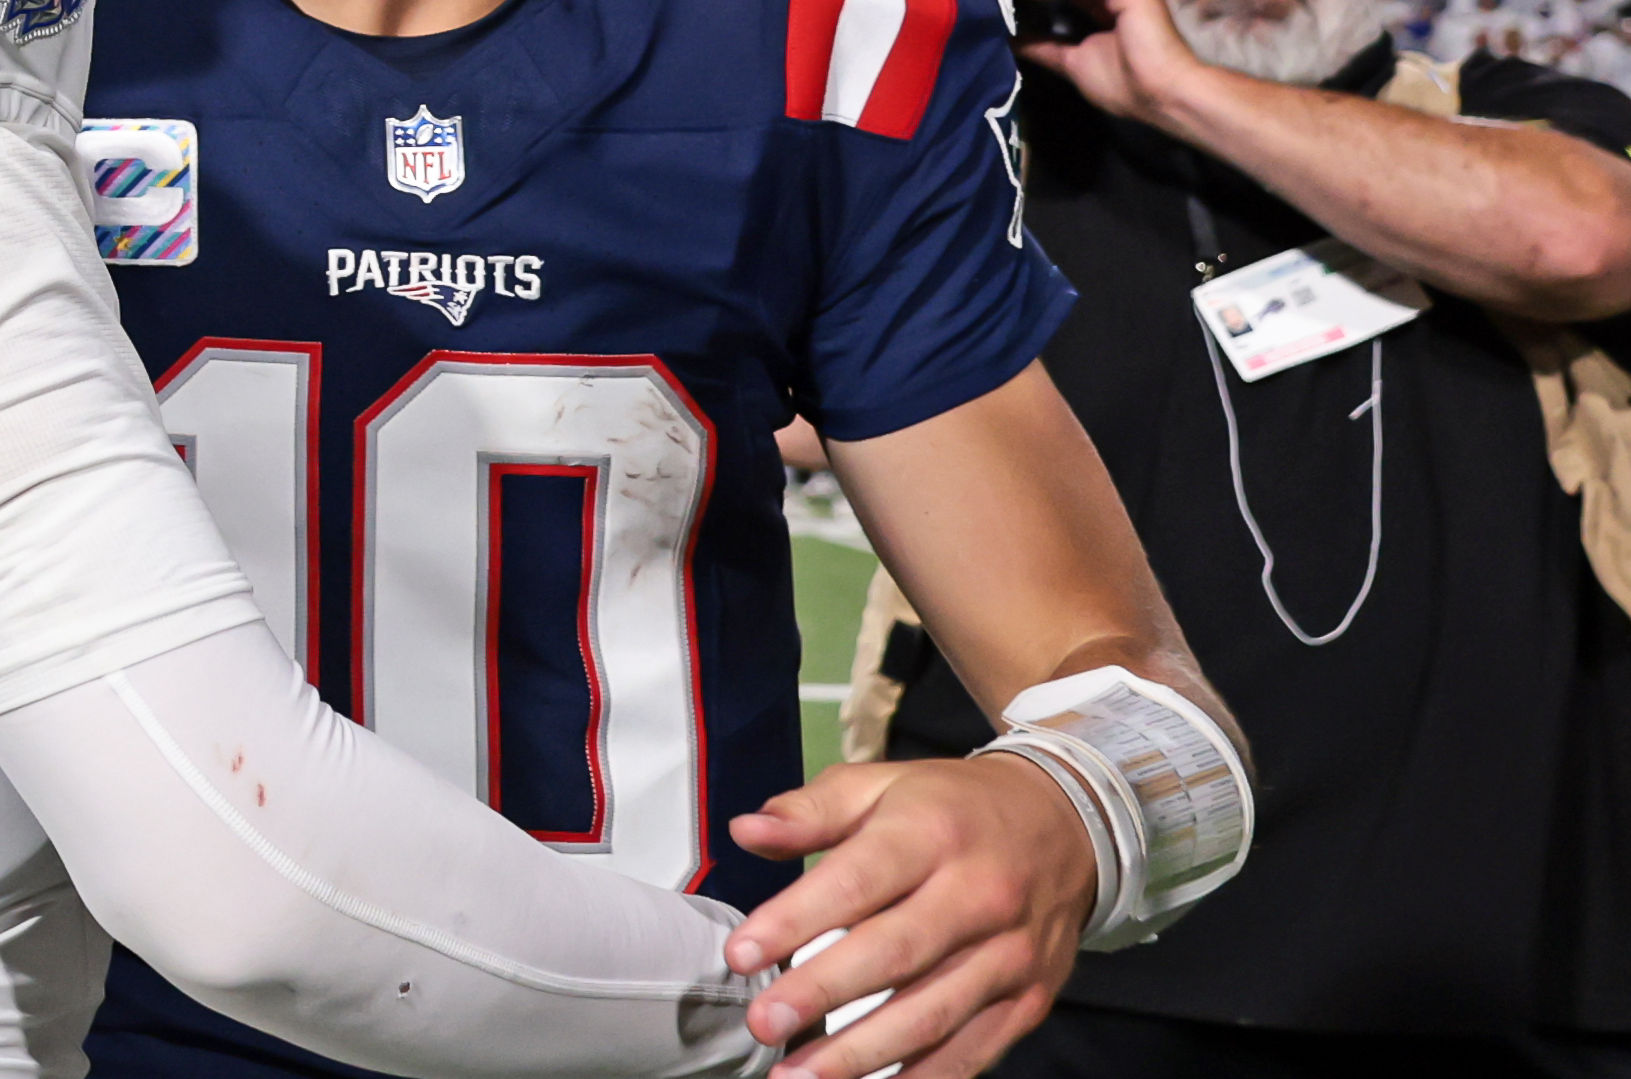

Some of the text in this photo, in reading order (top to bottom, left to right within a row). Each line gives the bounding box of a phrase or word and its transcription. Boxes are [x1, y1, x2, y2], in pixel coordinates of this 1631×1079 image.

[400, 150, 452, 184] NFL
[325, 248, 545, 301] PATRIOTS
[153, 336, 718, 894] 10
